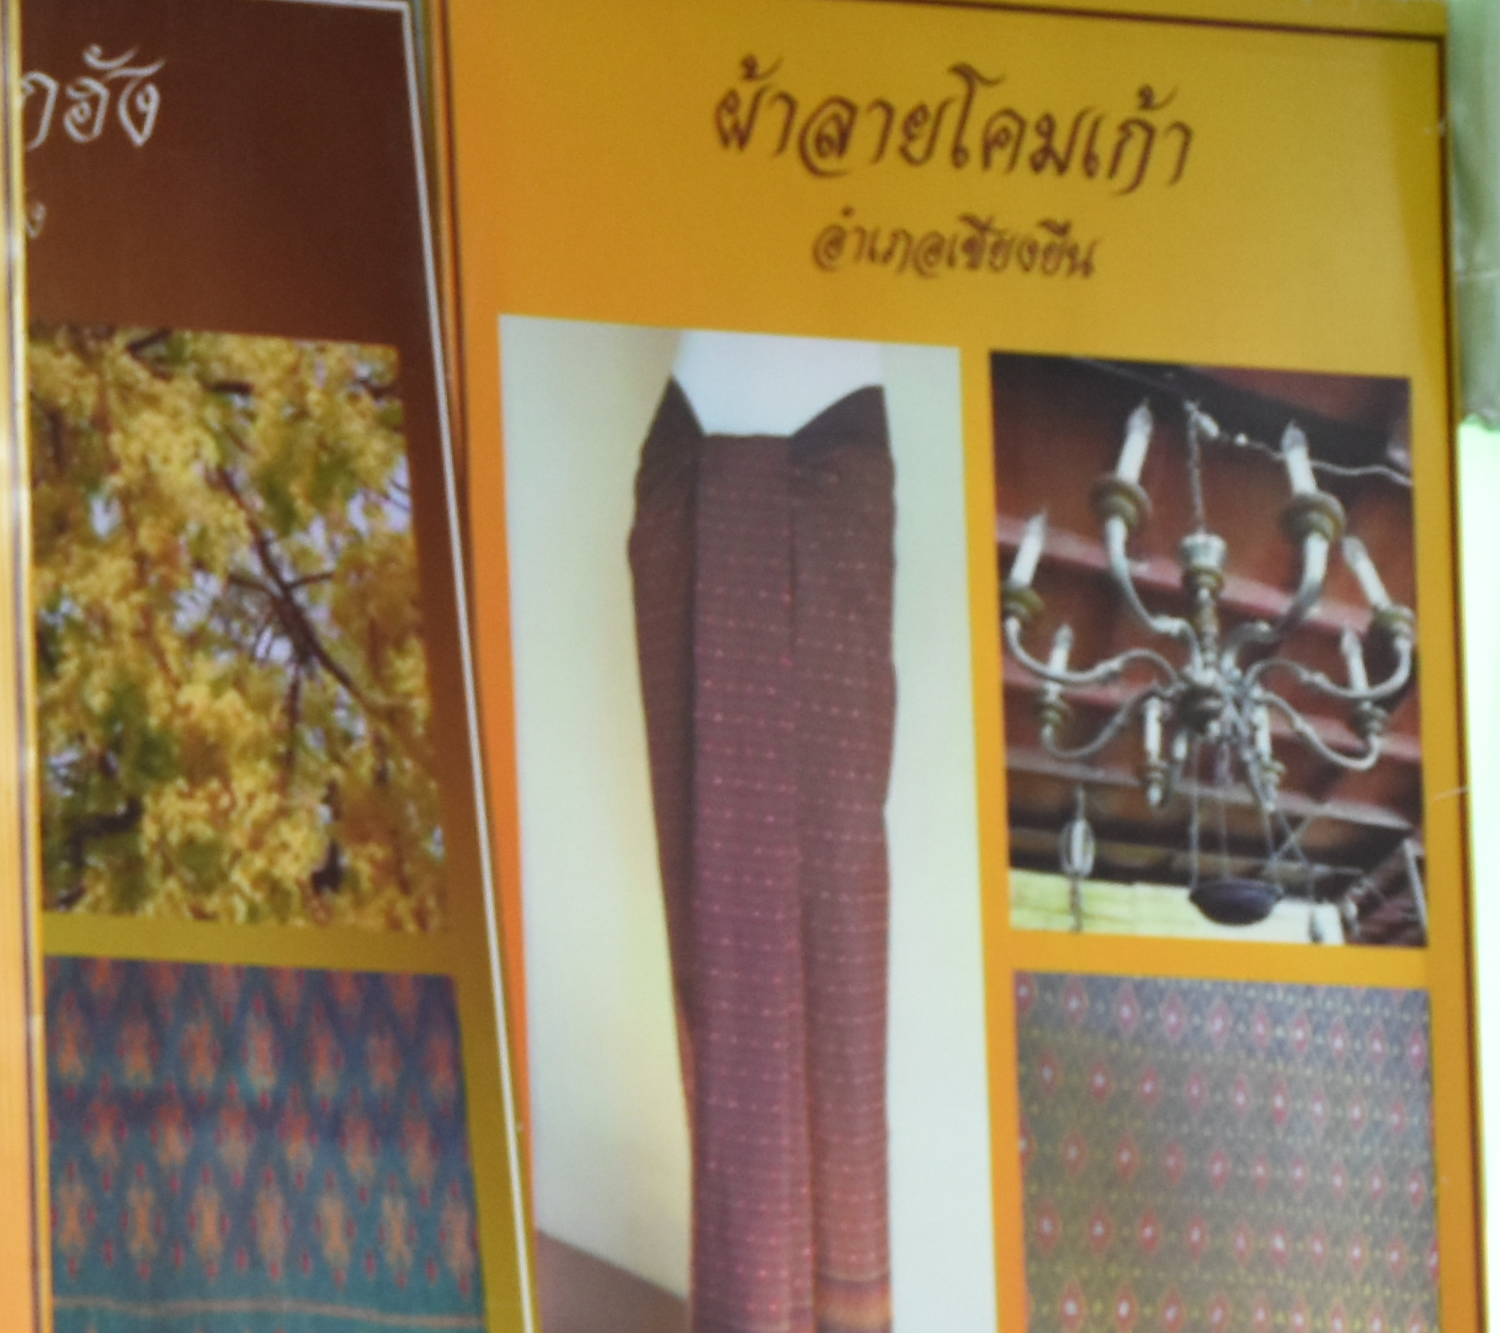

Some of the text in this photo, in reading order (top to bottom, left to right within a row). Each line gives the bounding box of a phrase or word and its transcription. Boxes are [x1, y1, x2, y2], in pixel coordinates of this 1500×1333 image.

[715, 54, 1193, 195] ผ้าลายโคมเก้า
[813, 206, 1096, 278] อำเภอเชียงยืน
